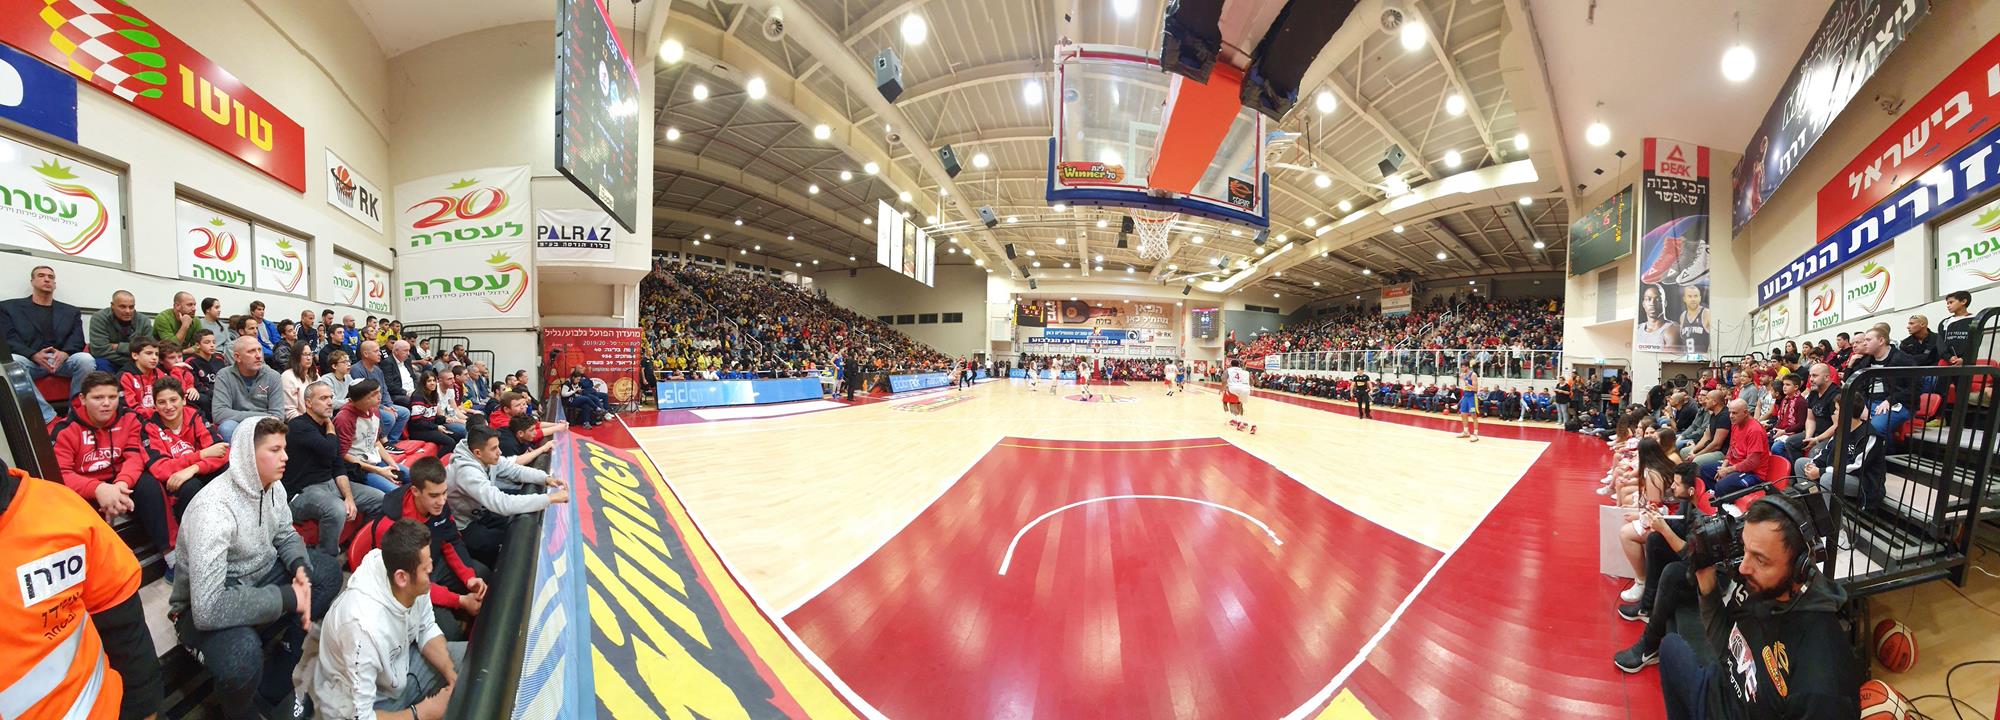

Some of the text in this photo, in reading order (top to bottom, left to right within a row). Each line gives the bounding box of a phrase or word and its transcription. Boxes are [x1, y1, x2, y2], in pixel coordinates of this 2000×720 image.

[179, 64, 273, 152] טוטו
[1849, 90, 1973, 200] בישראל
[1063, 167, 1106, 178] Winner
[1106, 171, 1116, 179] סל
[1660, 162, 1691, 177] PEAK
[1647, 178, 1706, 194] הכי גבוה
[359, 185, 380, 222] RK
[1655, 190, 1698, 205] שאפשר
[405, 187, 510, 229] 20
[1763, 130, 2000, 301] זורית הגלבוע
[411, 221, 523, 247] לעטרה
[537, 225, 612, 241] PALRAZ
[188, 227, 239, 262] 20
[261, 254, 292, 272] עטרה
[193, 264, 246, 285] לעטרה
[404, 274, 510, 297] עטרה
[1847, 280, 1877, 300] עטרה
[1813, 288, 1835, 317] 20
[1812, 312, 1840, 329] לעטרה
[589, 328, 614, 337] הפועל
[615, 329, 641, 338] מועדון
[82, 431, 95, 445] 12
[85, 449, 121, 461] GILBOA
[24, 555, 83, 600] סדרן
